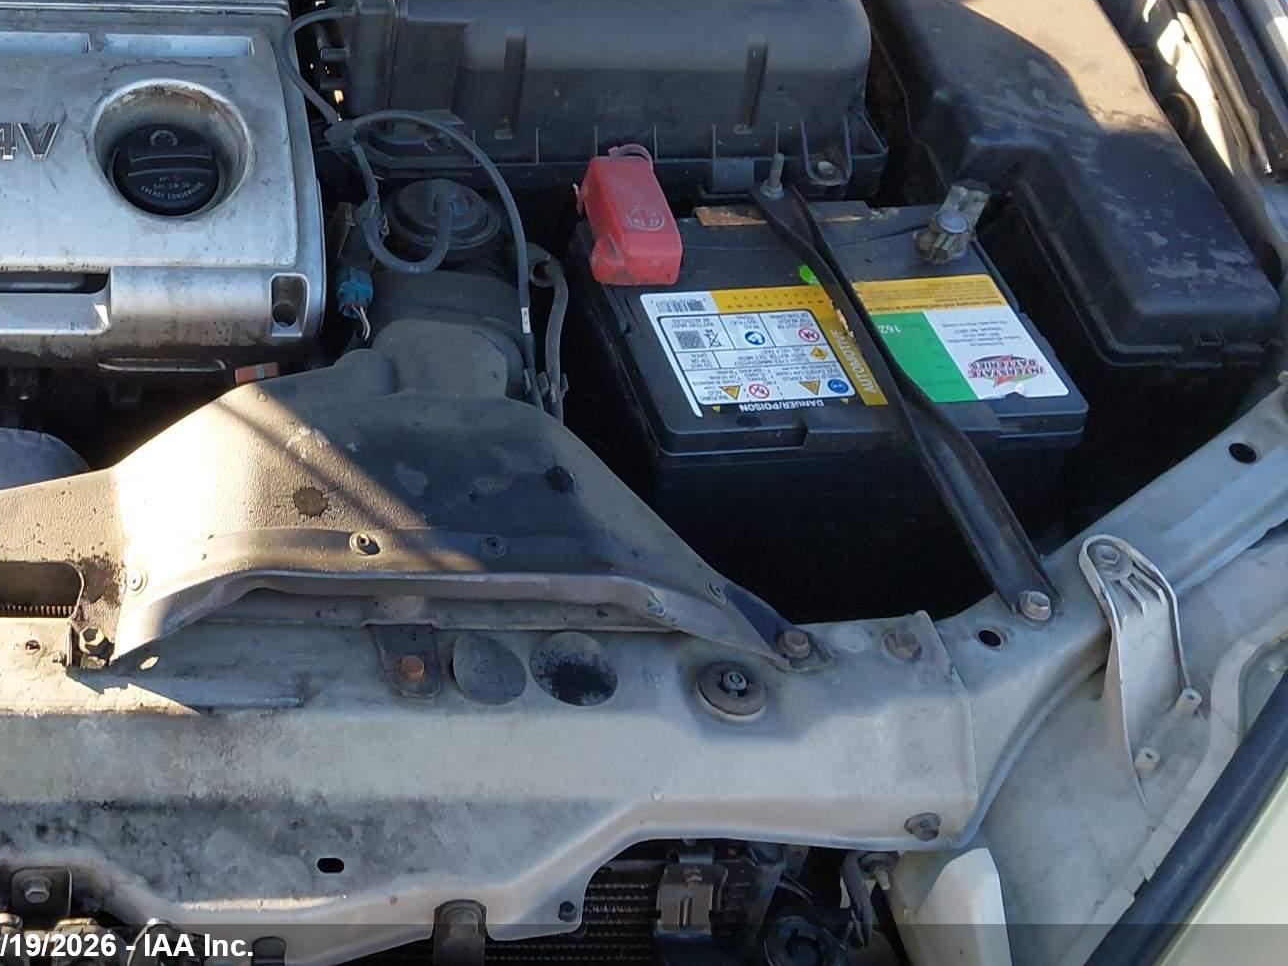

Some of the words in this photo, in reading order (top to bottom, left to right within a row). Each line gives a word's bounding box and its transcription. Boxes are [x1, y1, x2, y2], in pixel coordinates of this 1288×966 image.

[968, 359, 1036, 371] BATTERIES
[967, 366, 1044, 379] INTERSTATE
[740, 398, 824, 412] DANGER/POISON
